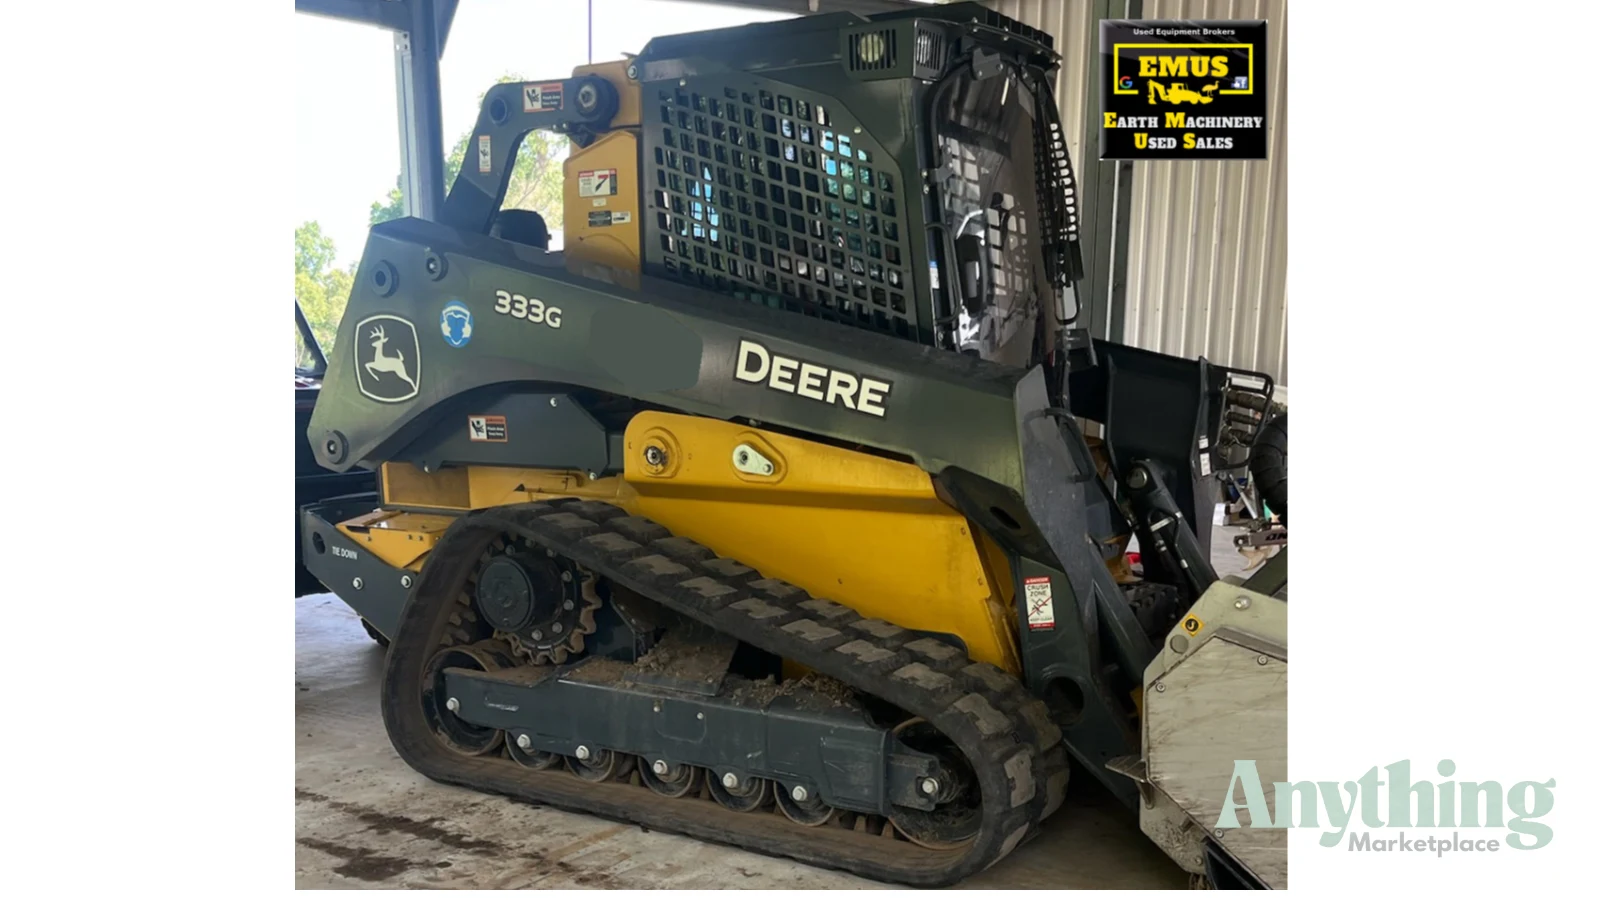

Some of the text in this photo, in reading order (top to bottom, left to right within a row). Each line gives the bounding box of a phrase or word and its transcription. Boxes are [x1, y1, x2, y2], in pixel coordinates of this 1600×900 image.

[494, 289, 562, 328] 333G
[735, 340, 890, 417] DEERE
[332, 546, 358, 560] TIE DOWN
